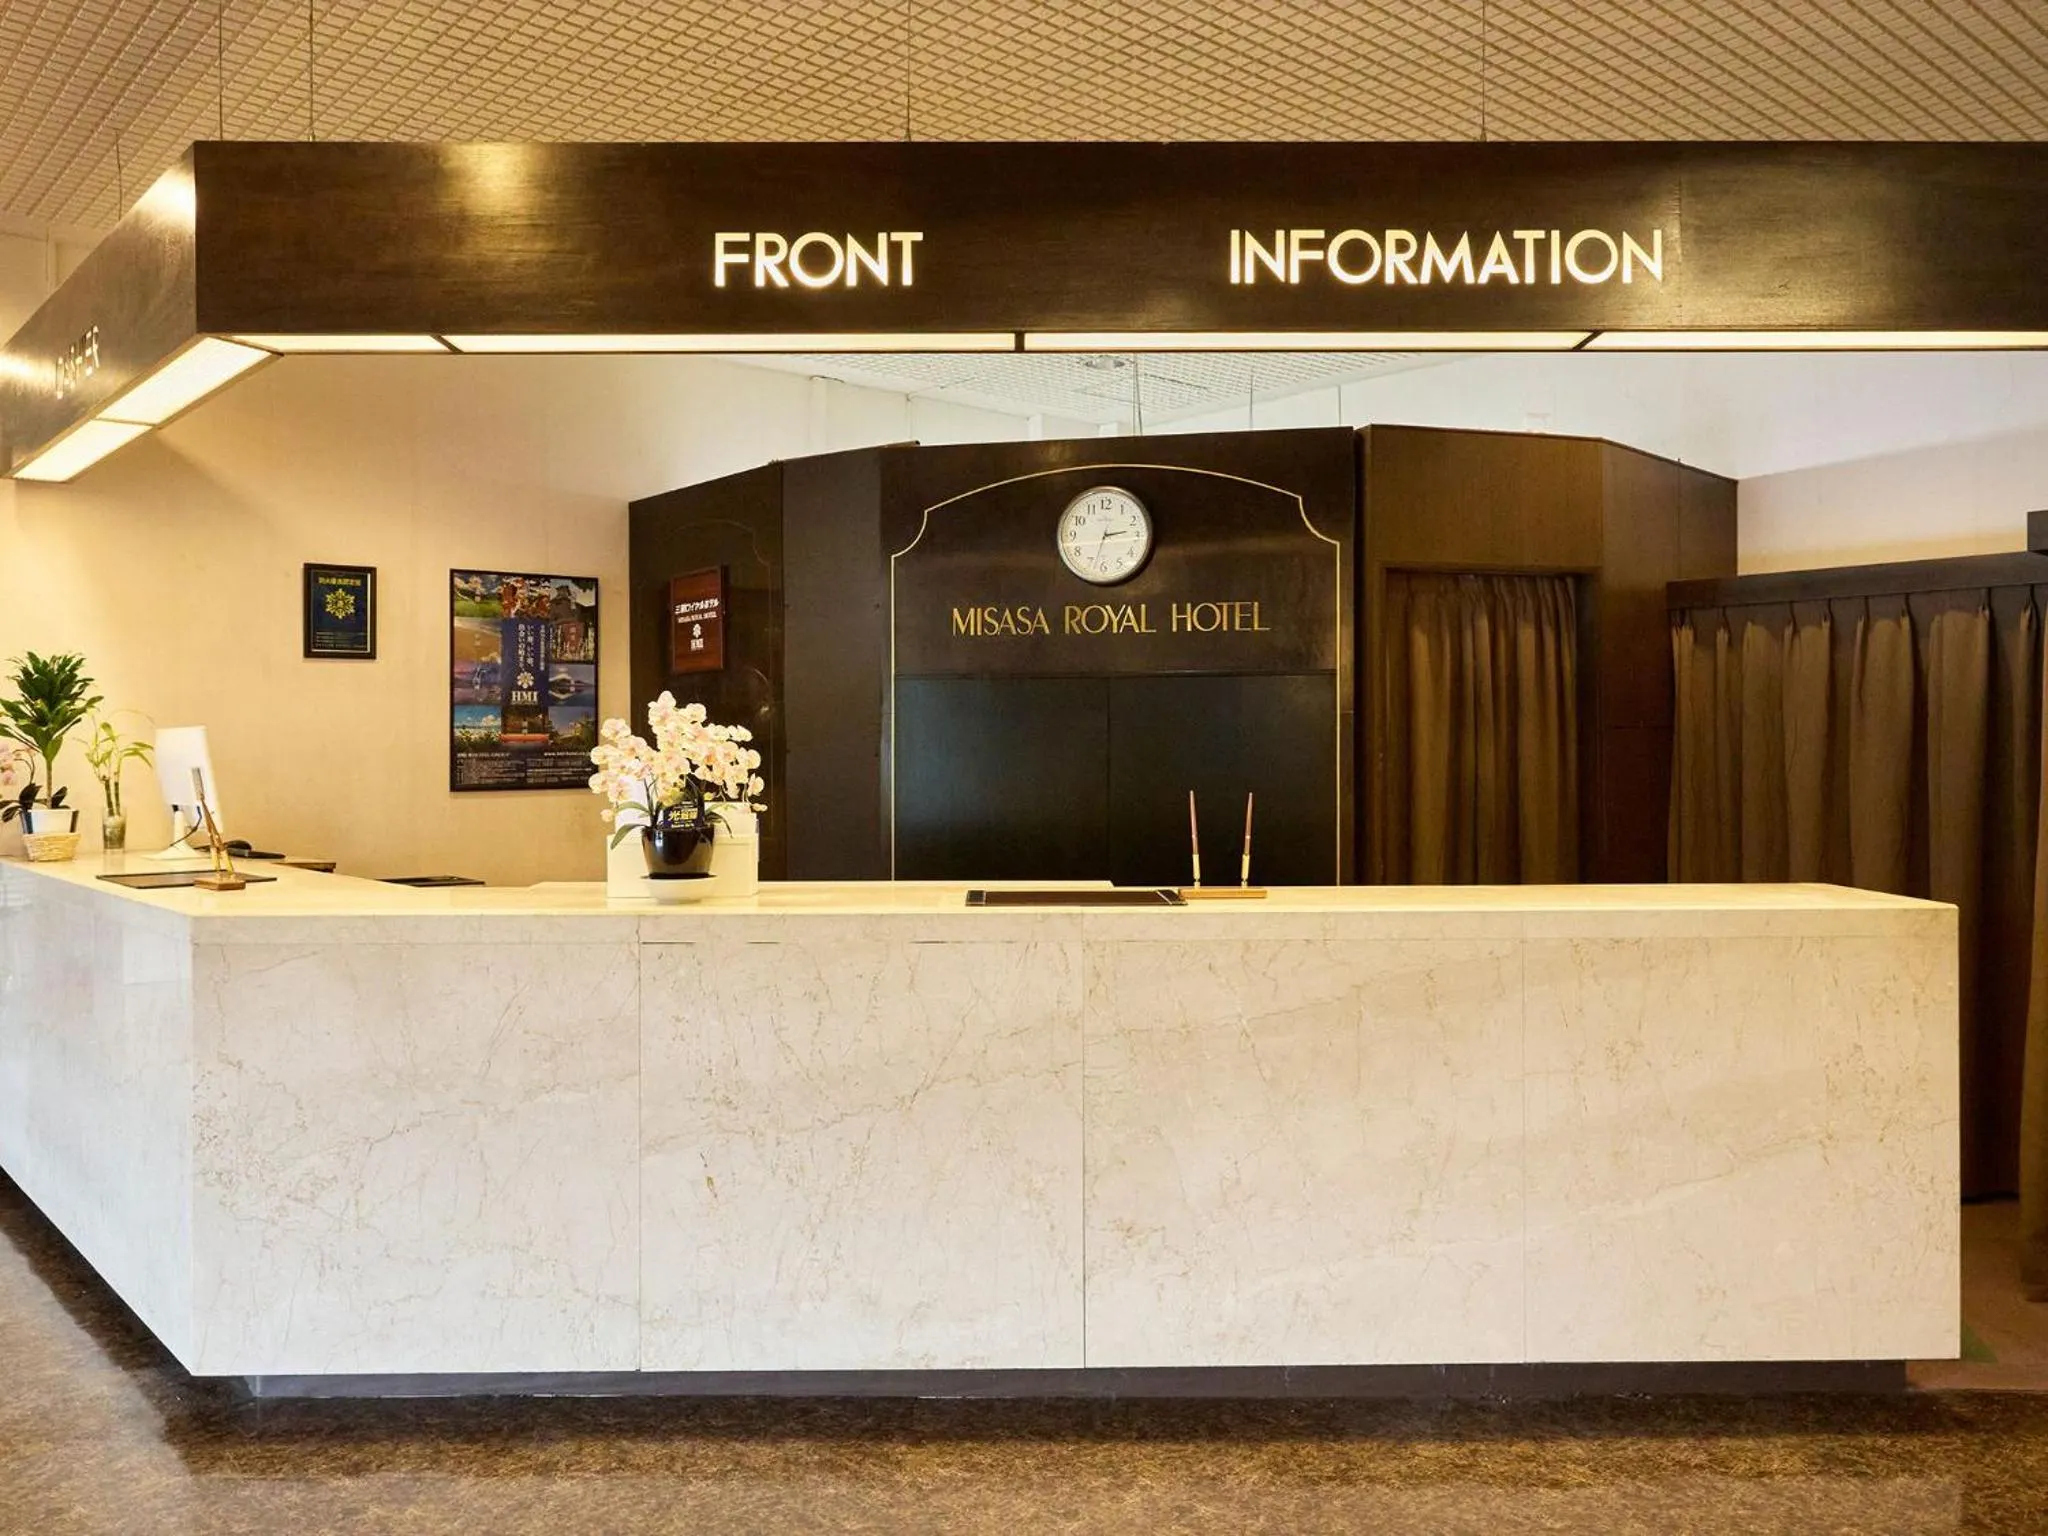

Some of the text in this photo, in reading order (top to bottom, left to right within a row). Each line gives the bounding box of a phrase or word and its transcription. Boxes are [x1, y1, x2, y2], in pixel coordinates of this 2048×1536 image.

[715, 231, 923, 287] FRONT
[1230, 228, 1663, 284] INFORMATION
[1087, 504, 1096, 515] 11
[1101, 499, 1112, 510] 12
[1075, 515, 1086, 526] 10
[1130, 515, 1137, 526] 2
[1070, 531, 1077, 542] 9
[1074, 546, 1081, 557] 8
[1126, 546, 1134, 557] 4
[1087, 556, 1095, 567] 7
[1100, 561, 1108, 572] 6
[1116, 558, 1123, 569] 5
[952, 602, 1271, 636] MISASA ROYAL HOTEL
[512, 691, 538, 702] HMI
